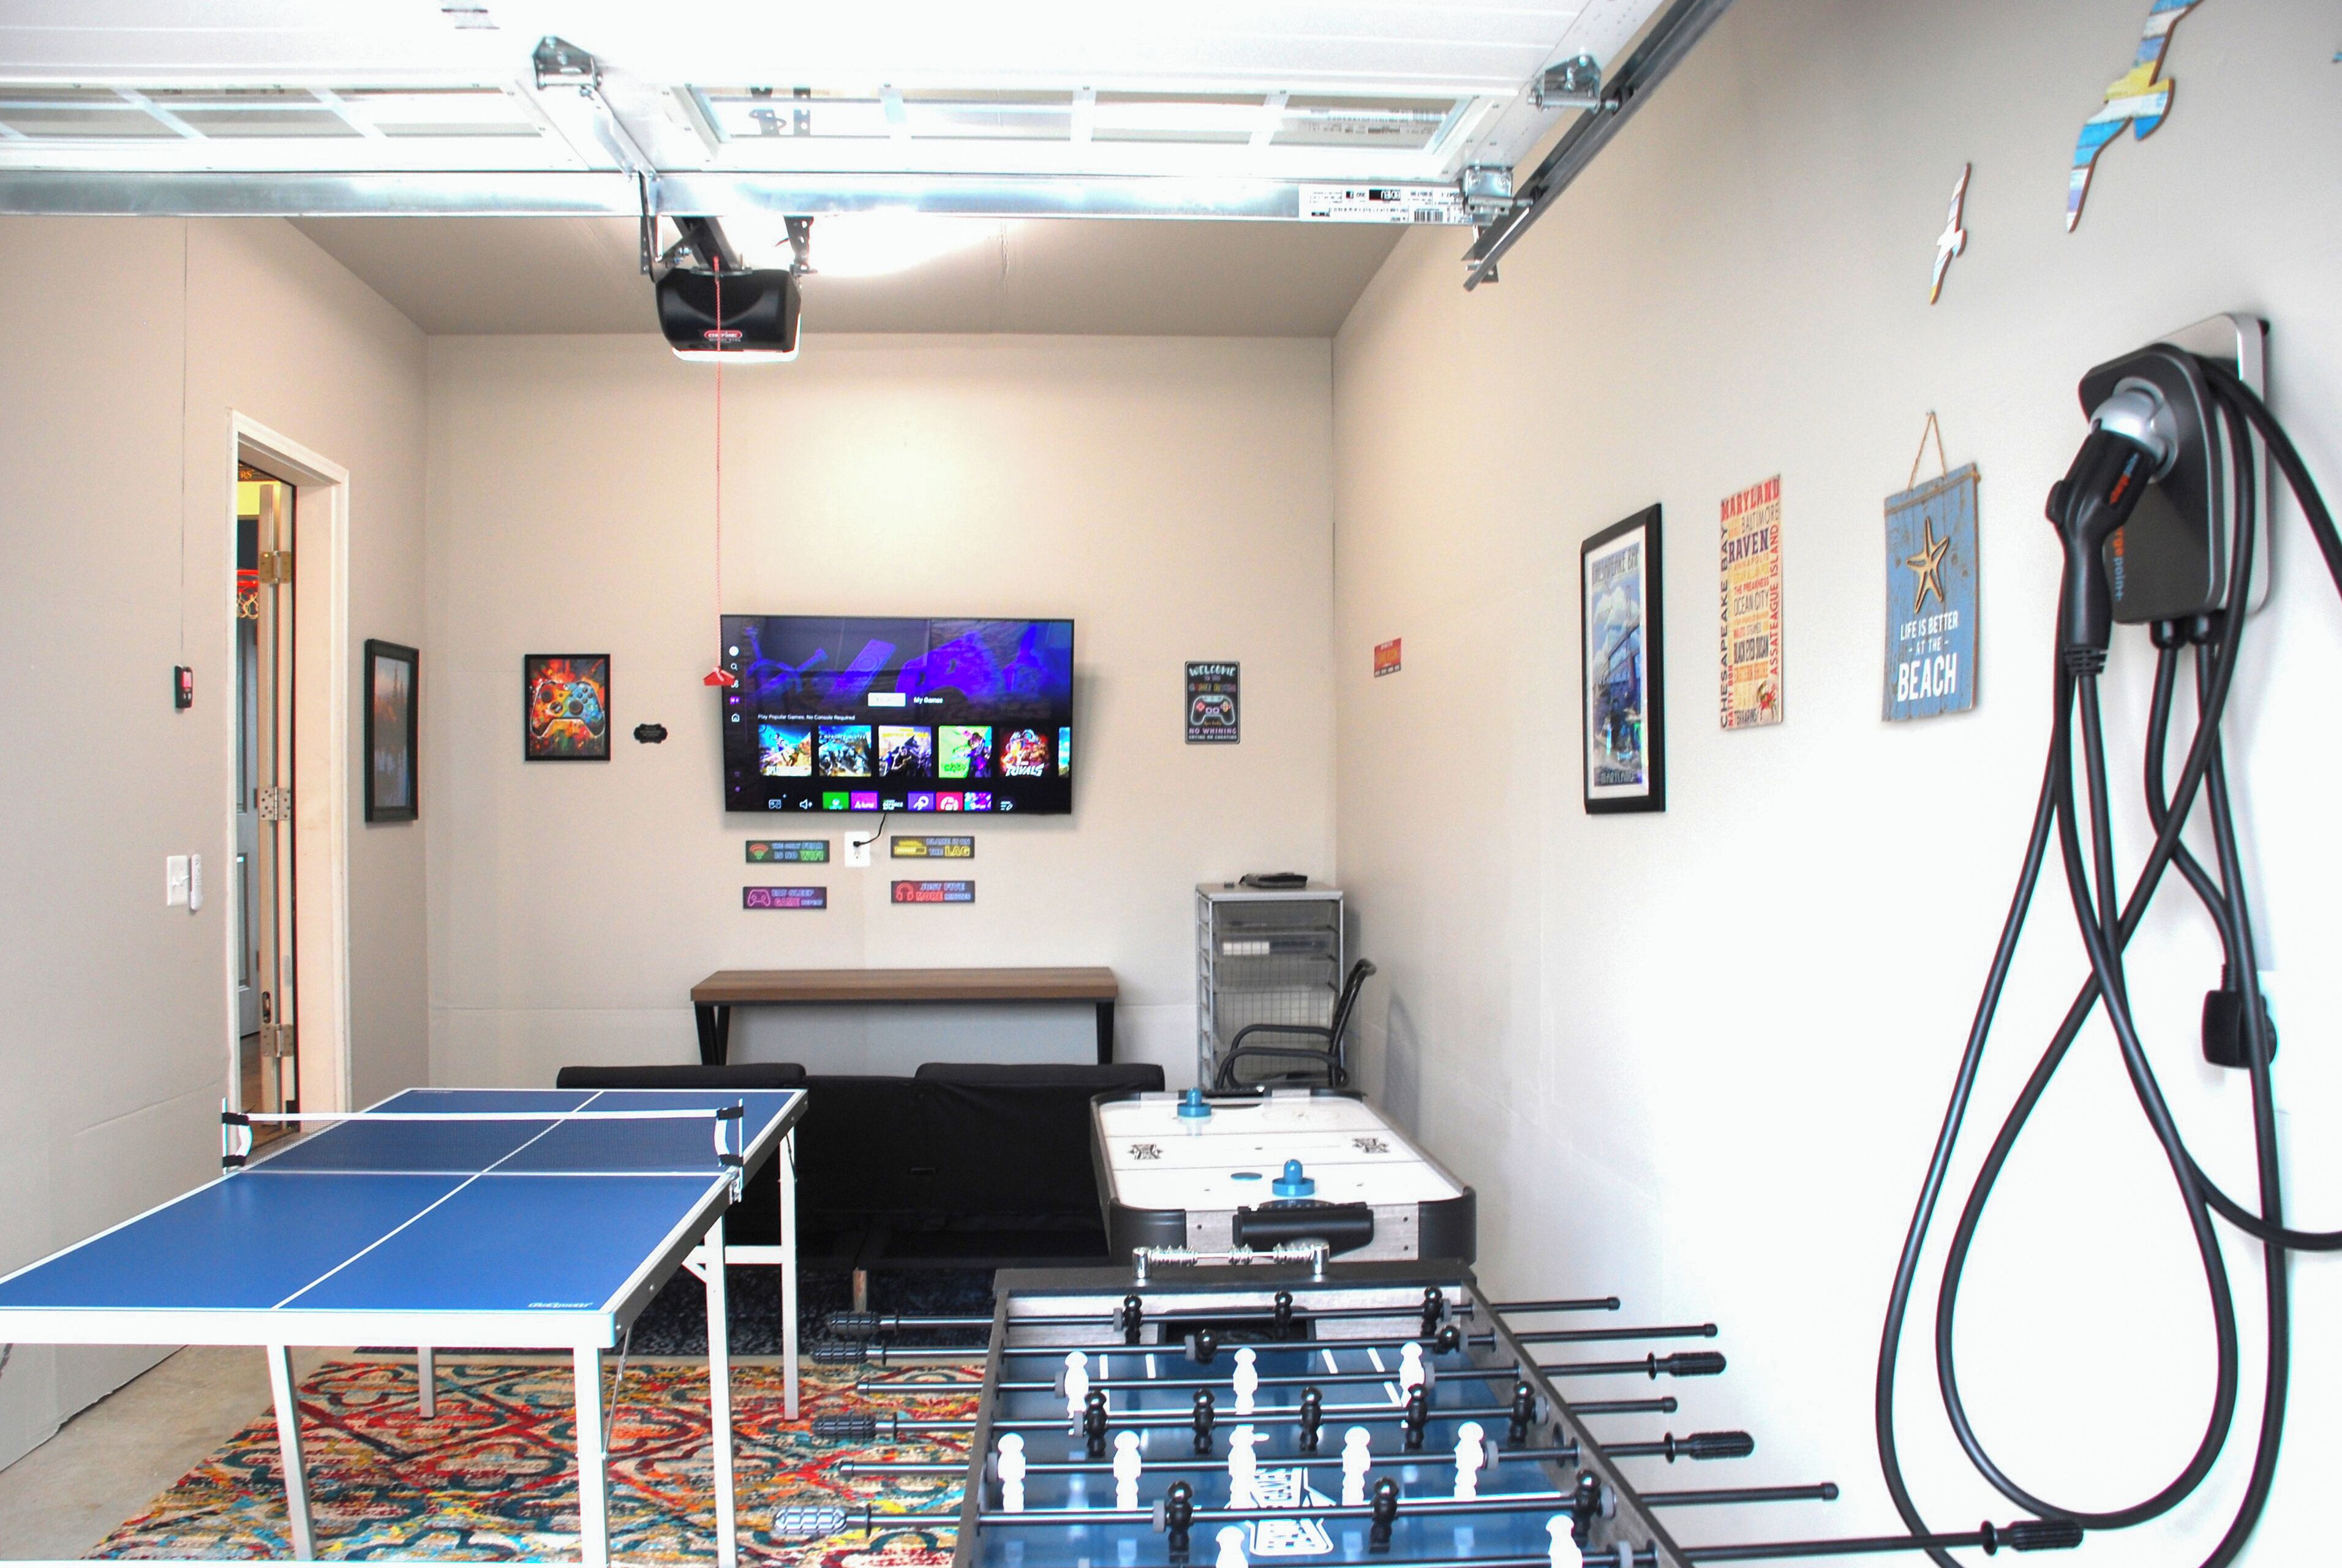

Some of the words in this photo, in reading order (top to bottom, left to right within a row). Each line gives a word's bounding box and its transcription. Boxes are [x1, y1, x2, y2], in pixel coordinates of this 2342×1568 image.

[1721, 478, 1780, 522] MARYLAND
[1741, 503, 1779, 533] BALTIMORE
[1728, 528, 1769, 564] RAVEN
[1770, 524, 1779, 577] ISLAND
[1734, 593, 1753, 616] OCEAN
[1754, 590, 1769, 611] CITY
[1770, 582, 1779, 675] ASSATEAGUE
[1900, 619, 1917, 641] LIFE
[1918, 618, 1926, 636] IS
[1928, 609, 1958, 635] BETTER
[1915, 639, 1925, 656] AT
[1929, 636, 1941, 653] THE
[1189, 665, 1236, 677] WELCOME
[1897, 652, 1957, 703] BEACH
[1005, 763, 1045, 777] RIVALS
[800, 850, 824, 861] WIFI
[944, 845, 970, 856] LAG
[916, 891, 943, 902] MORE
[921, 883, 942, 891] JUST
[944, 883, 965, 891] FIVE
[774, 897, 800, 907] GAME
